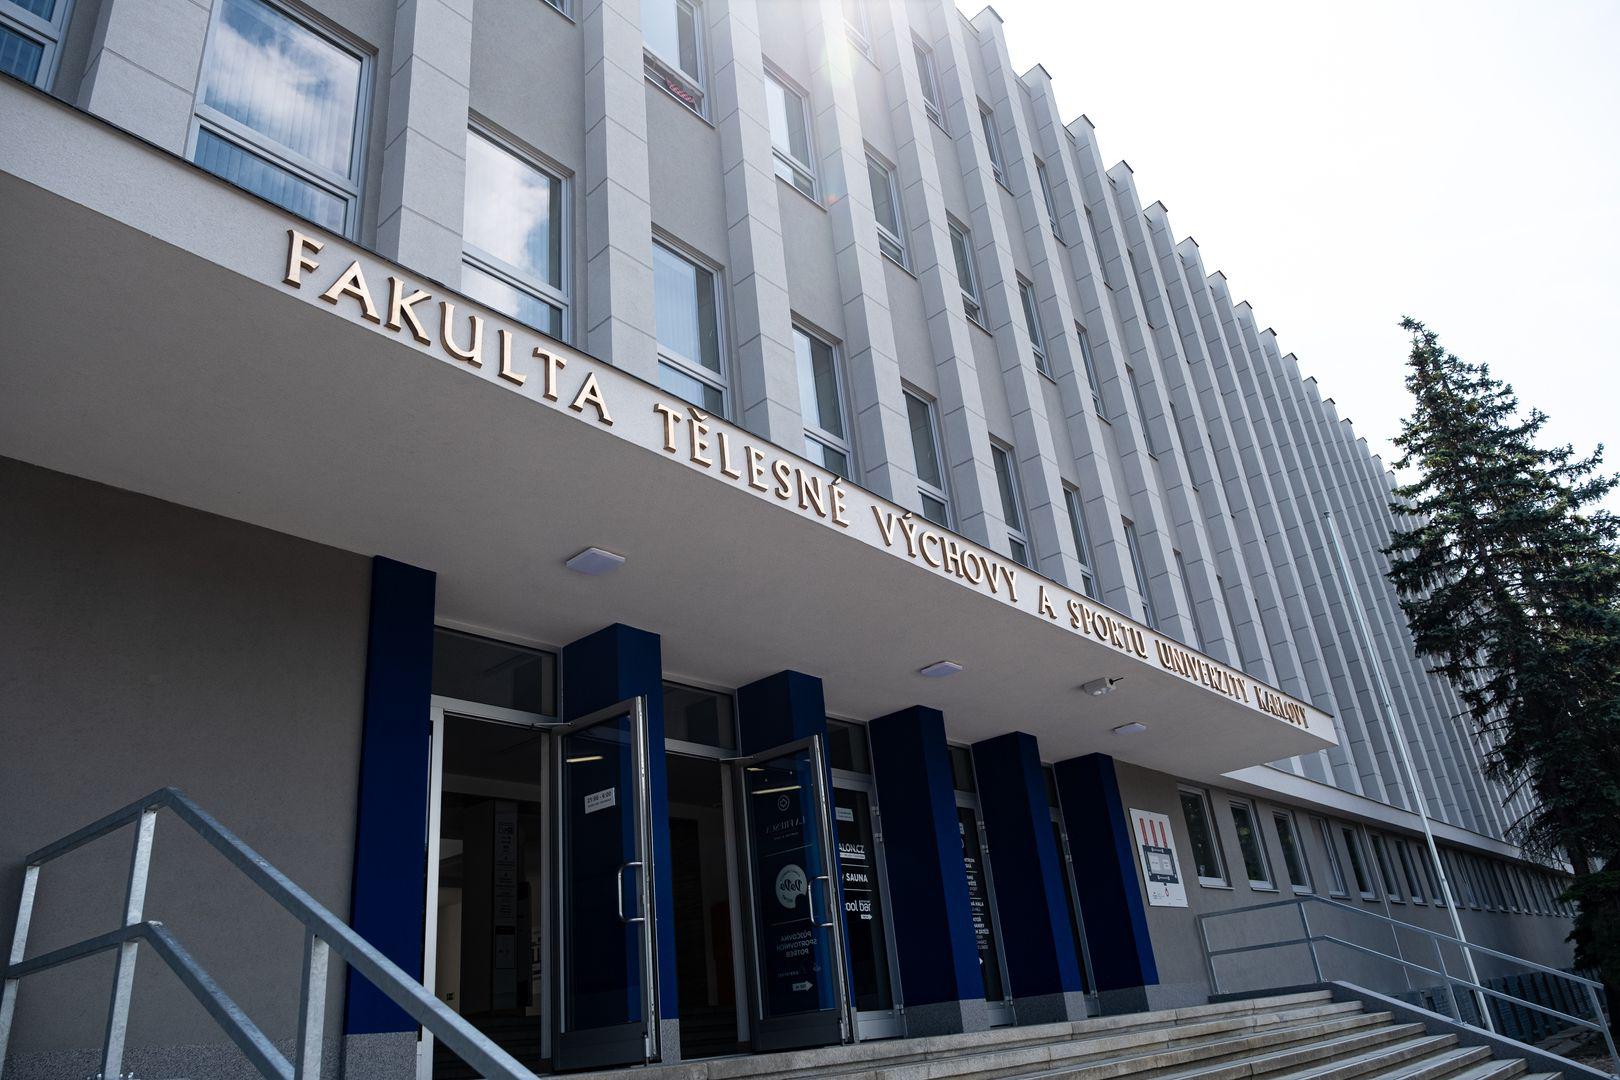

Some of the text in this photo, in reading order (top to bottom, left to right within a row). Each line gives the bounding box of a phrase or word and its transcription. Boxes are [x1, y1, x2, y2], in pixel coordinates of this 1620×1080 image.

[282, 229, 1309, 729] FAKULTA TĚLESNÉ VÝCHOVY A SPORTU UNIVERZITY KARLOVY
[838, 843, 865, 853] ALON.CZ
[846, 872, 869, 882] SAUNA
[845, 899, 859, 911] ool
